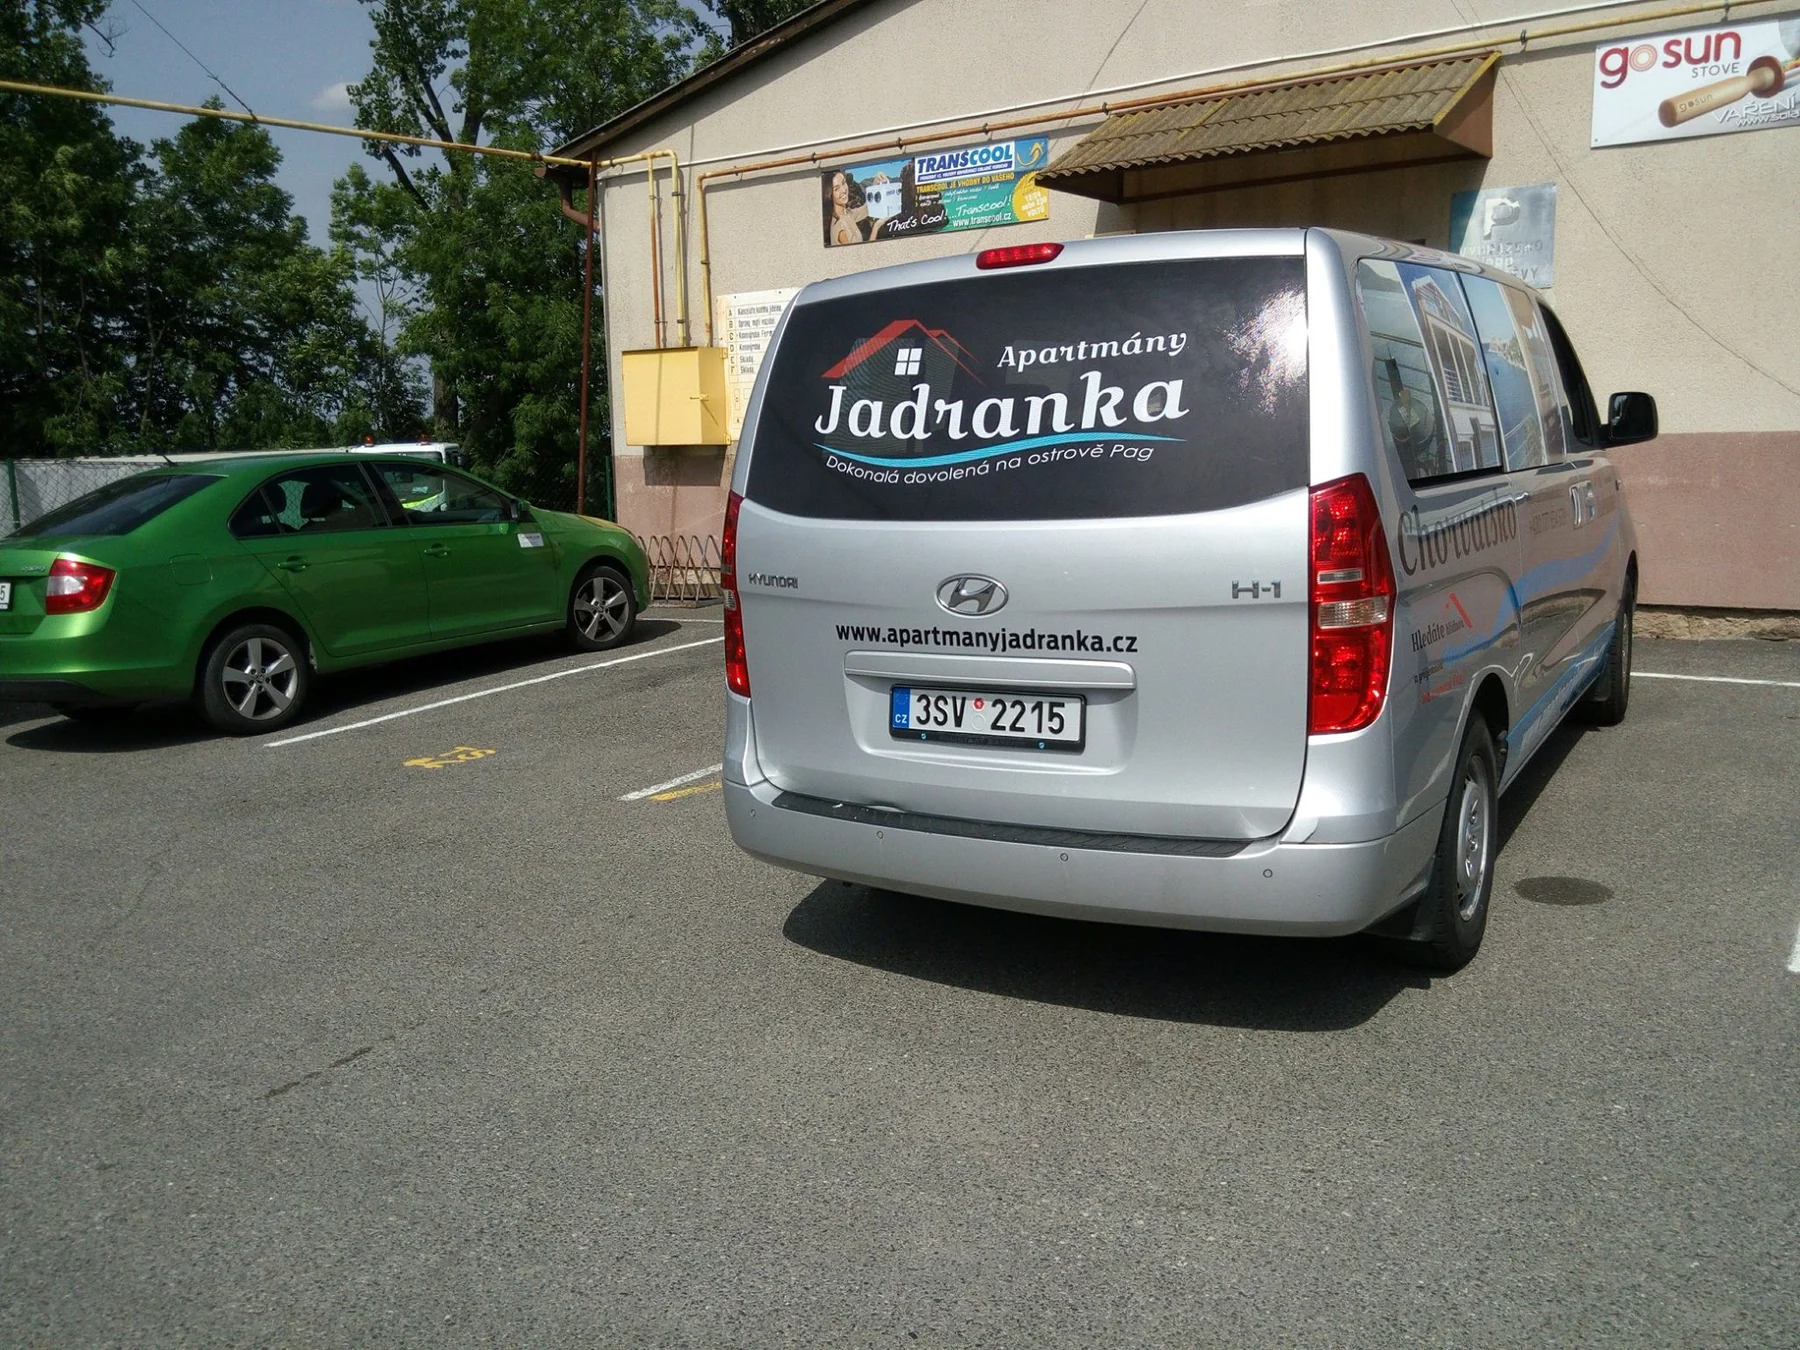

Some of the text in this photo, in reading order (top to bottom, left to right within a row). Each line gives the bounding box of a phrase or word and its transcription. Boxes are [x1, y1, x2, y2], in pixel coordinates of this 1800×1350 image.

[1691, 62, 1740, 79] STOVE
[917, 144, 1013, 173] TRANSCOOL
[916, 183, 949, 193] TRANSCOOL
[887, 208, 948, 232] That's Cool!
[953, 211, 1011, 228] www.transcool.cz
[997, 331, 1188, 373] Apartmány
[814, 371, 1190, 440] Jadranka
[825, 442, 1155, 485] Dokonalá dovolená na ostrově Pag
[1398, 489, 1517, 577] Chorvatsko
[748, 572, 799, 589] HYUNDAI
[1231, 580, 1282, 599] H-1
[835, 624, 1138, 653] www.apartmanyjadranka.cz
[1411, 622, 1445, 653] Hledáte
[895, 713, 908, 725] CZ
[915, 694, 1066, 735] 3SV 2215
